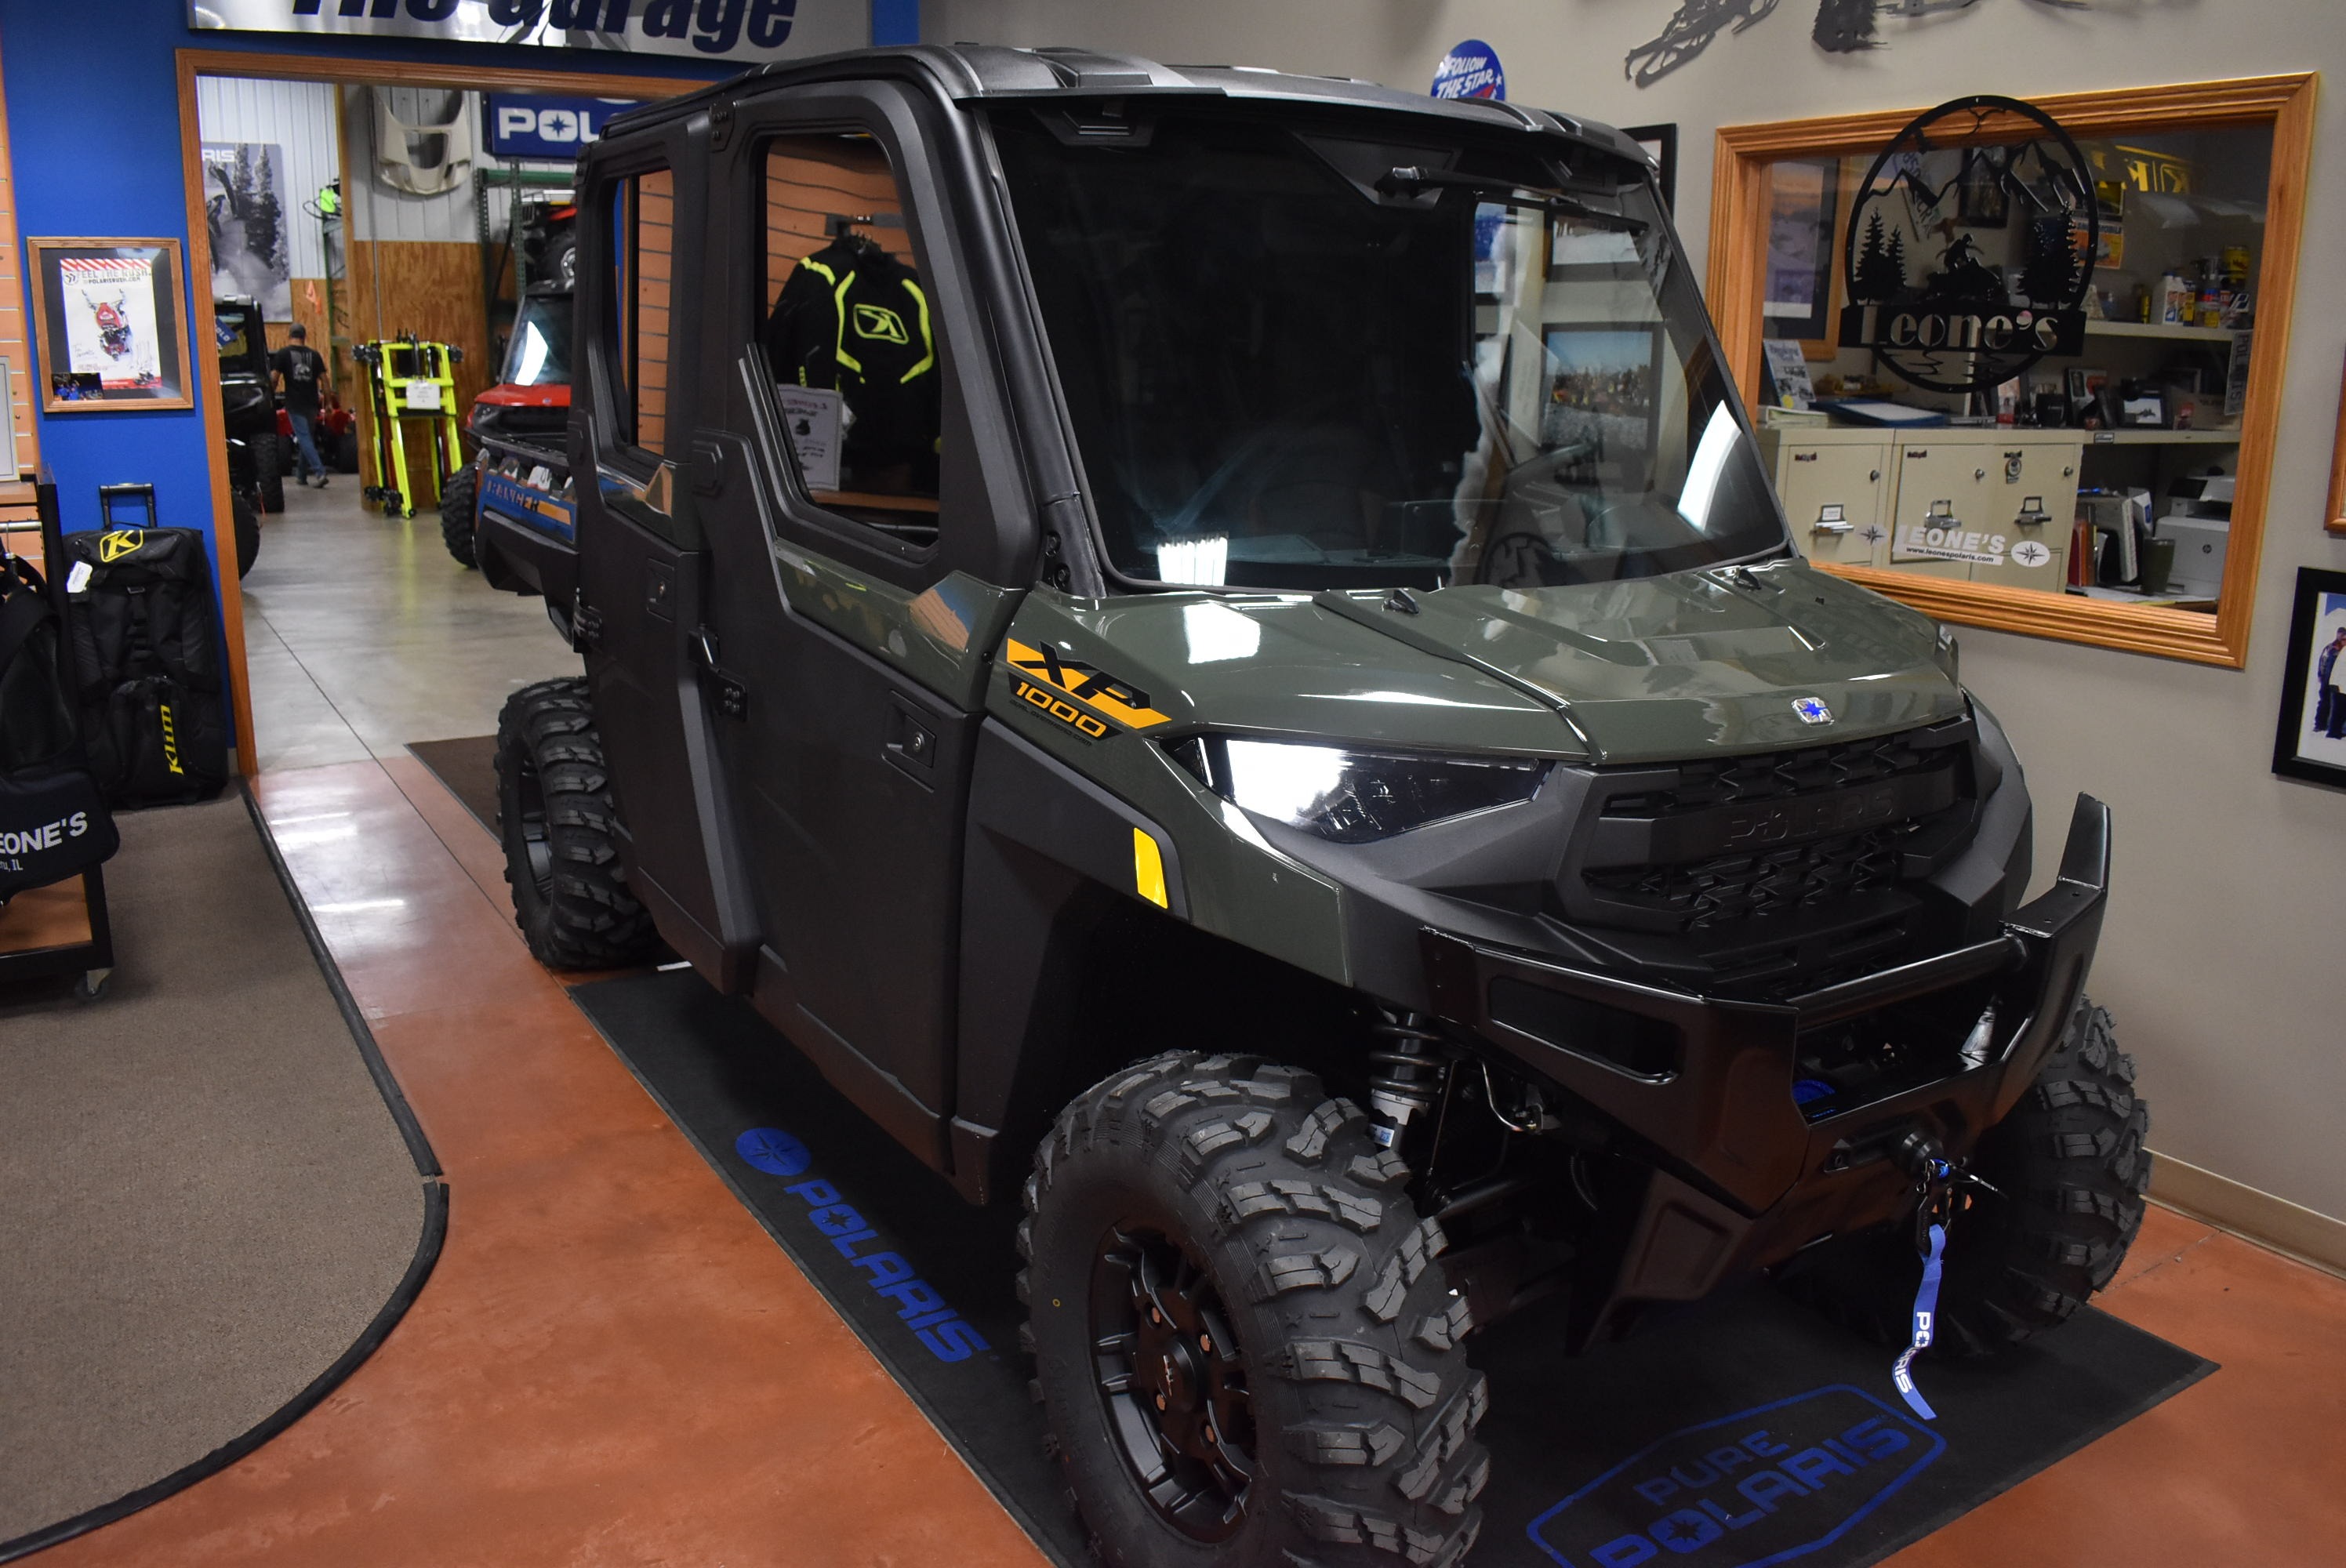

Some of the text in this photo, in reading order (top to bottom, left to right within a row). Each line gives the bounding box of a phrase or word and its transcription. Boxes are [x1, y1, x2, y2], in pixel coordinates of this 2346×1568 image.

[1436, 68, 1494, 99] THE STAR
[1448, 56, 1487, 76] FOLLOW
[1861, 305, 2058, 352] Leone's
[1893, 524, 2006, 554] LEONE'S
[1905, 546, 1995, 564] www.leonespolaris.com
[1011, 641, 1152, 710] XP
[1016, 681, 1107, 739] 1000
[784, 1178, 990, 1363] POLARIS
[1589, 1416, 1911, 1568] POLARIS
[1633, 1429, 1790, 1507] PURE
